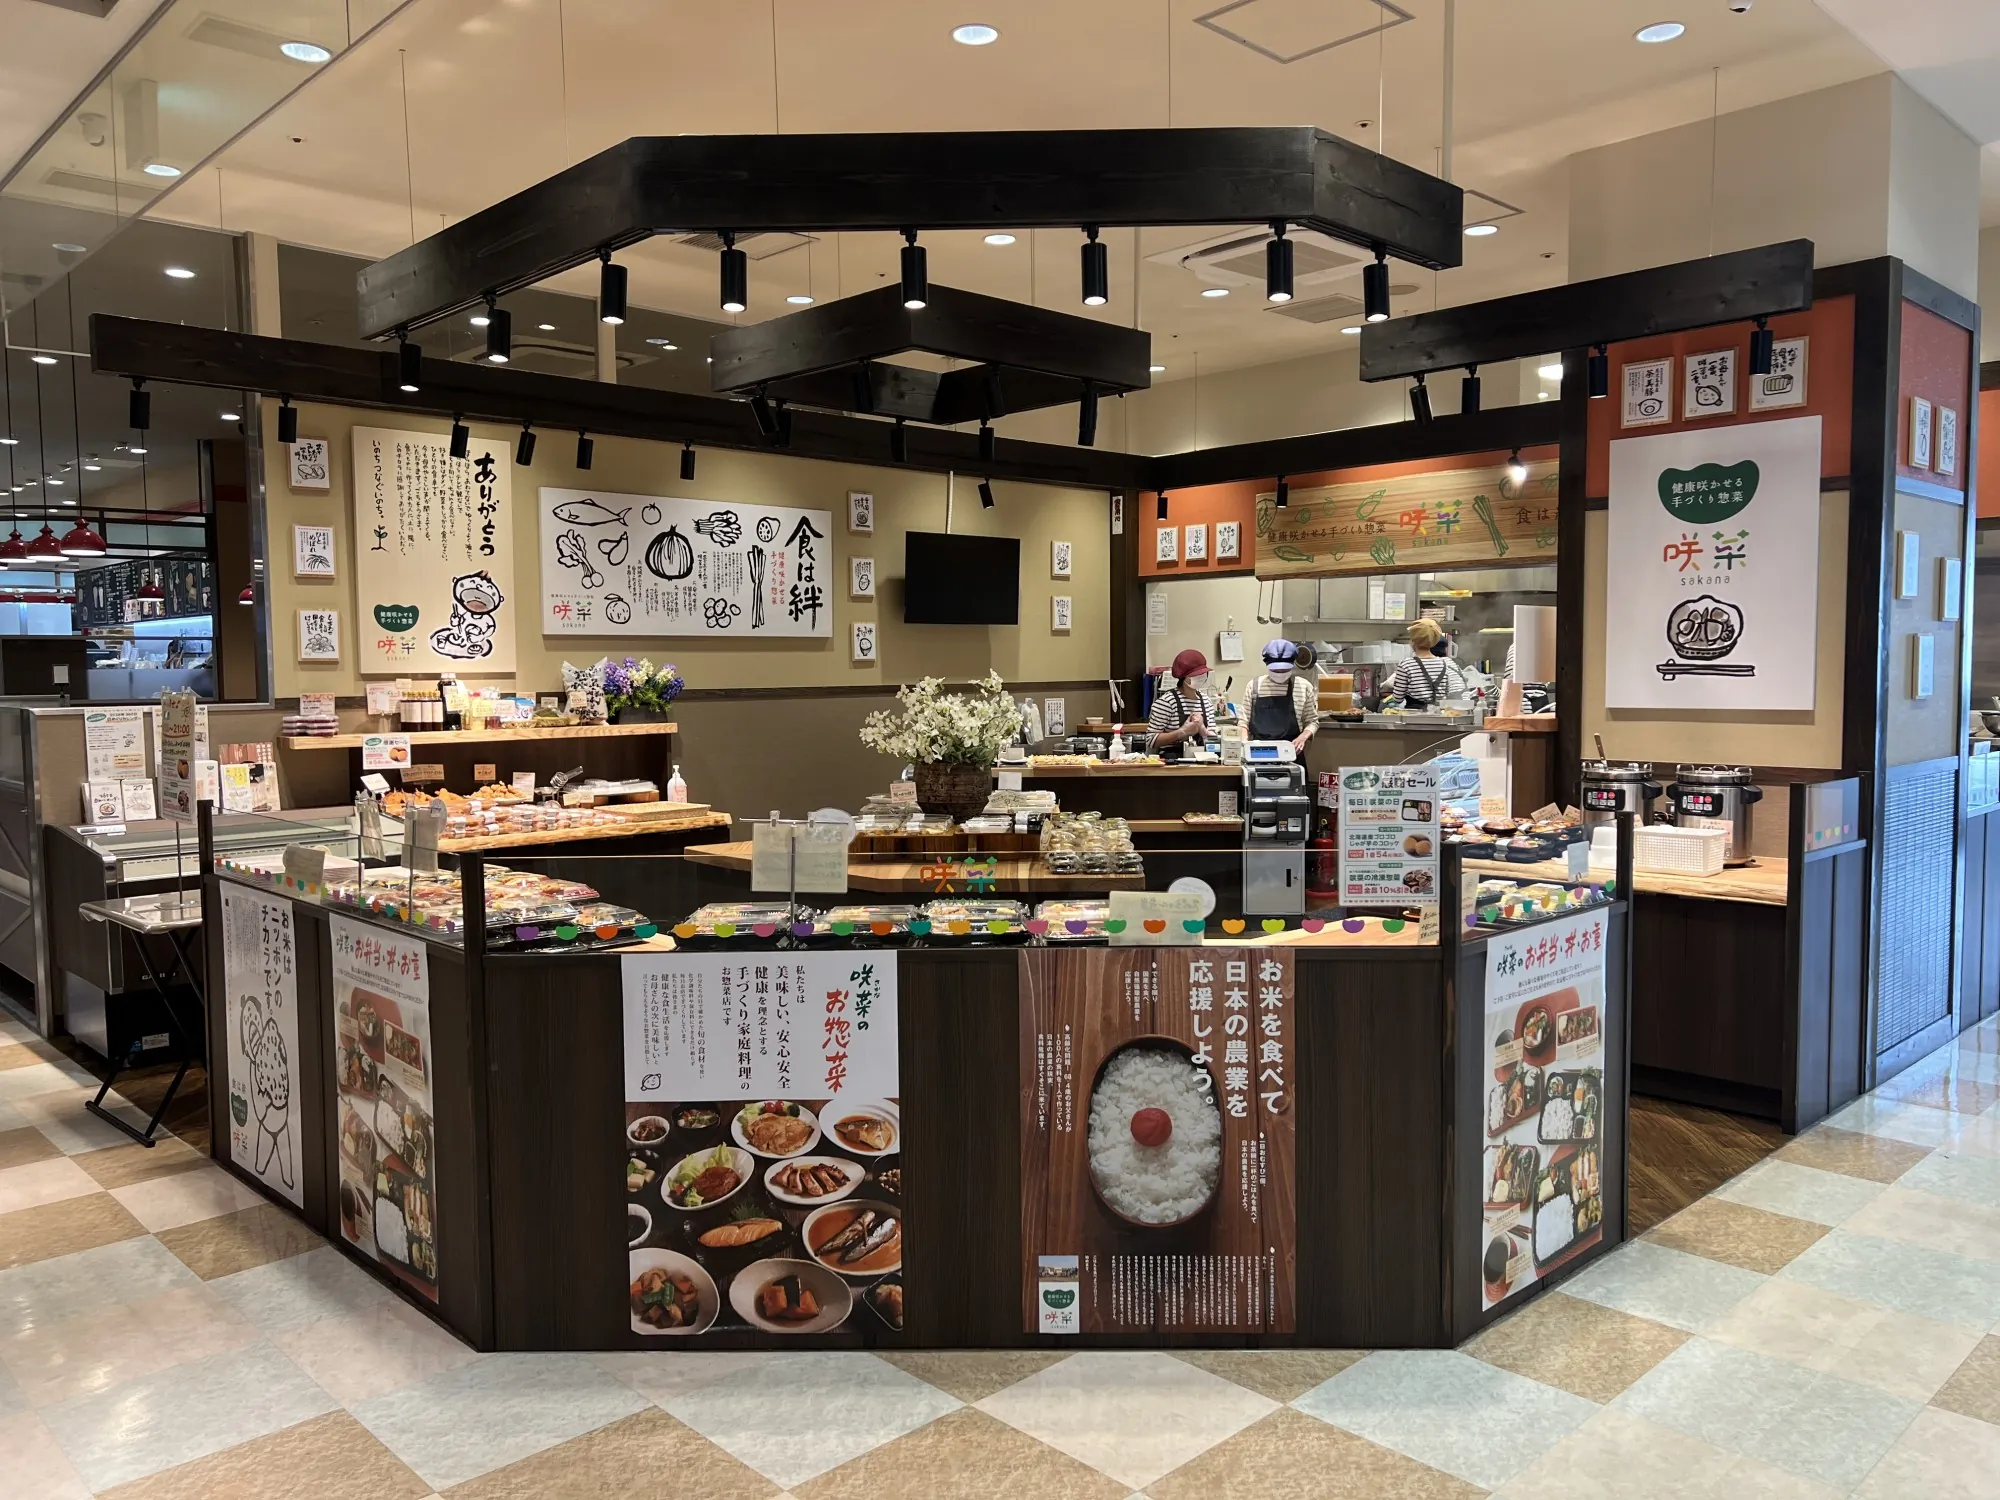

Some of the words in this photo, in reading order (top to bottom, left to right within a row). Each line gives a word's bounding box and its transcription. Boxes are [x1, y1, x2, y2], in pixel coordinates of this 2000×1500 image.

[372, 440, 384, 519] いのちつなぐいのち。
[474, 452, 500, 556] ありがとう
[1672, 478, 1744, 494] 健康咲かせる
[1672, 491, 1744, 507] 手づくり惣菜
[1267, 522, 1386, 544] 健康咲かせる手づくり惣菜
[1399, 500, 1463, 534] 咲菜
[1516, 507, 1559, 525] 食は
[786, 516, 824, 630] 食は絆
[1663, 529, 1750, 572] 咲菜
[1680, 574, 1730, 586] sakana
[553, 600, 592, 621] 咲菜
[378, 636, 416, 654] 咲菜
[920, 856, 997, 893] 咲菜
[262, 904, 274, 1015] チカラです。
[272, 907, 282, 1008] ニッポンの
[282, 910, 291, 974] お米は
[661, 974, 670, 1056] 健康な食生活を応援します
[722, 966, 732, 1026] お惣菜店です
[755, 966, 768, 1055] 健康を理念とする
[796, 965, 806, 1004] 私たちは
[850, 964, 874, 1031] 咲菜の
[651, 974, 660, 1065] お母さんの次に美味しいと
[736, 966, 752, 1090] 手づくり家庭料理の
[776, 966, 791, 1090] 美味しい、安心安全
[822, 987, 851, 1094] お惣菜
[1190, 960, 1214, 1104] 応援しよう。
[1225, 961, 1248, 1118] 日本の農業を
[1259, 959, 1284, 1114] お米を食べて
[1045, 1311, 1072, 1324] 咲菜
